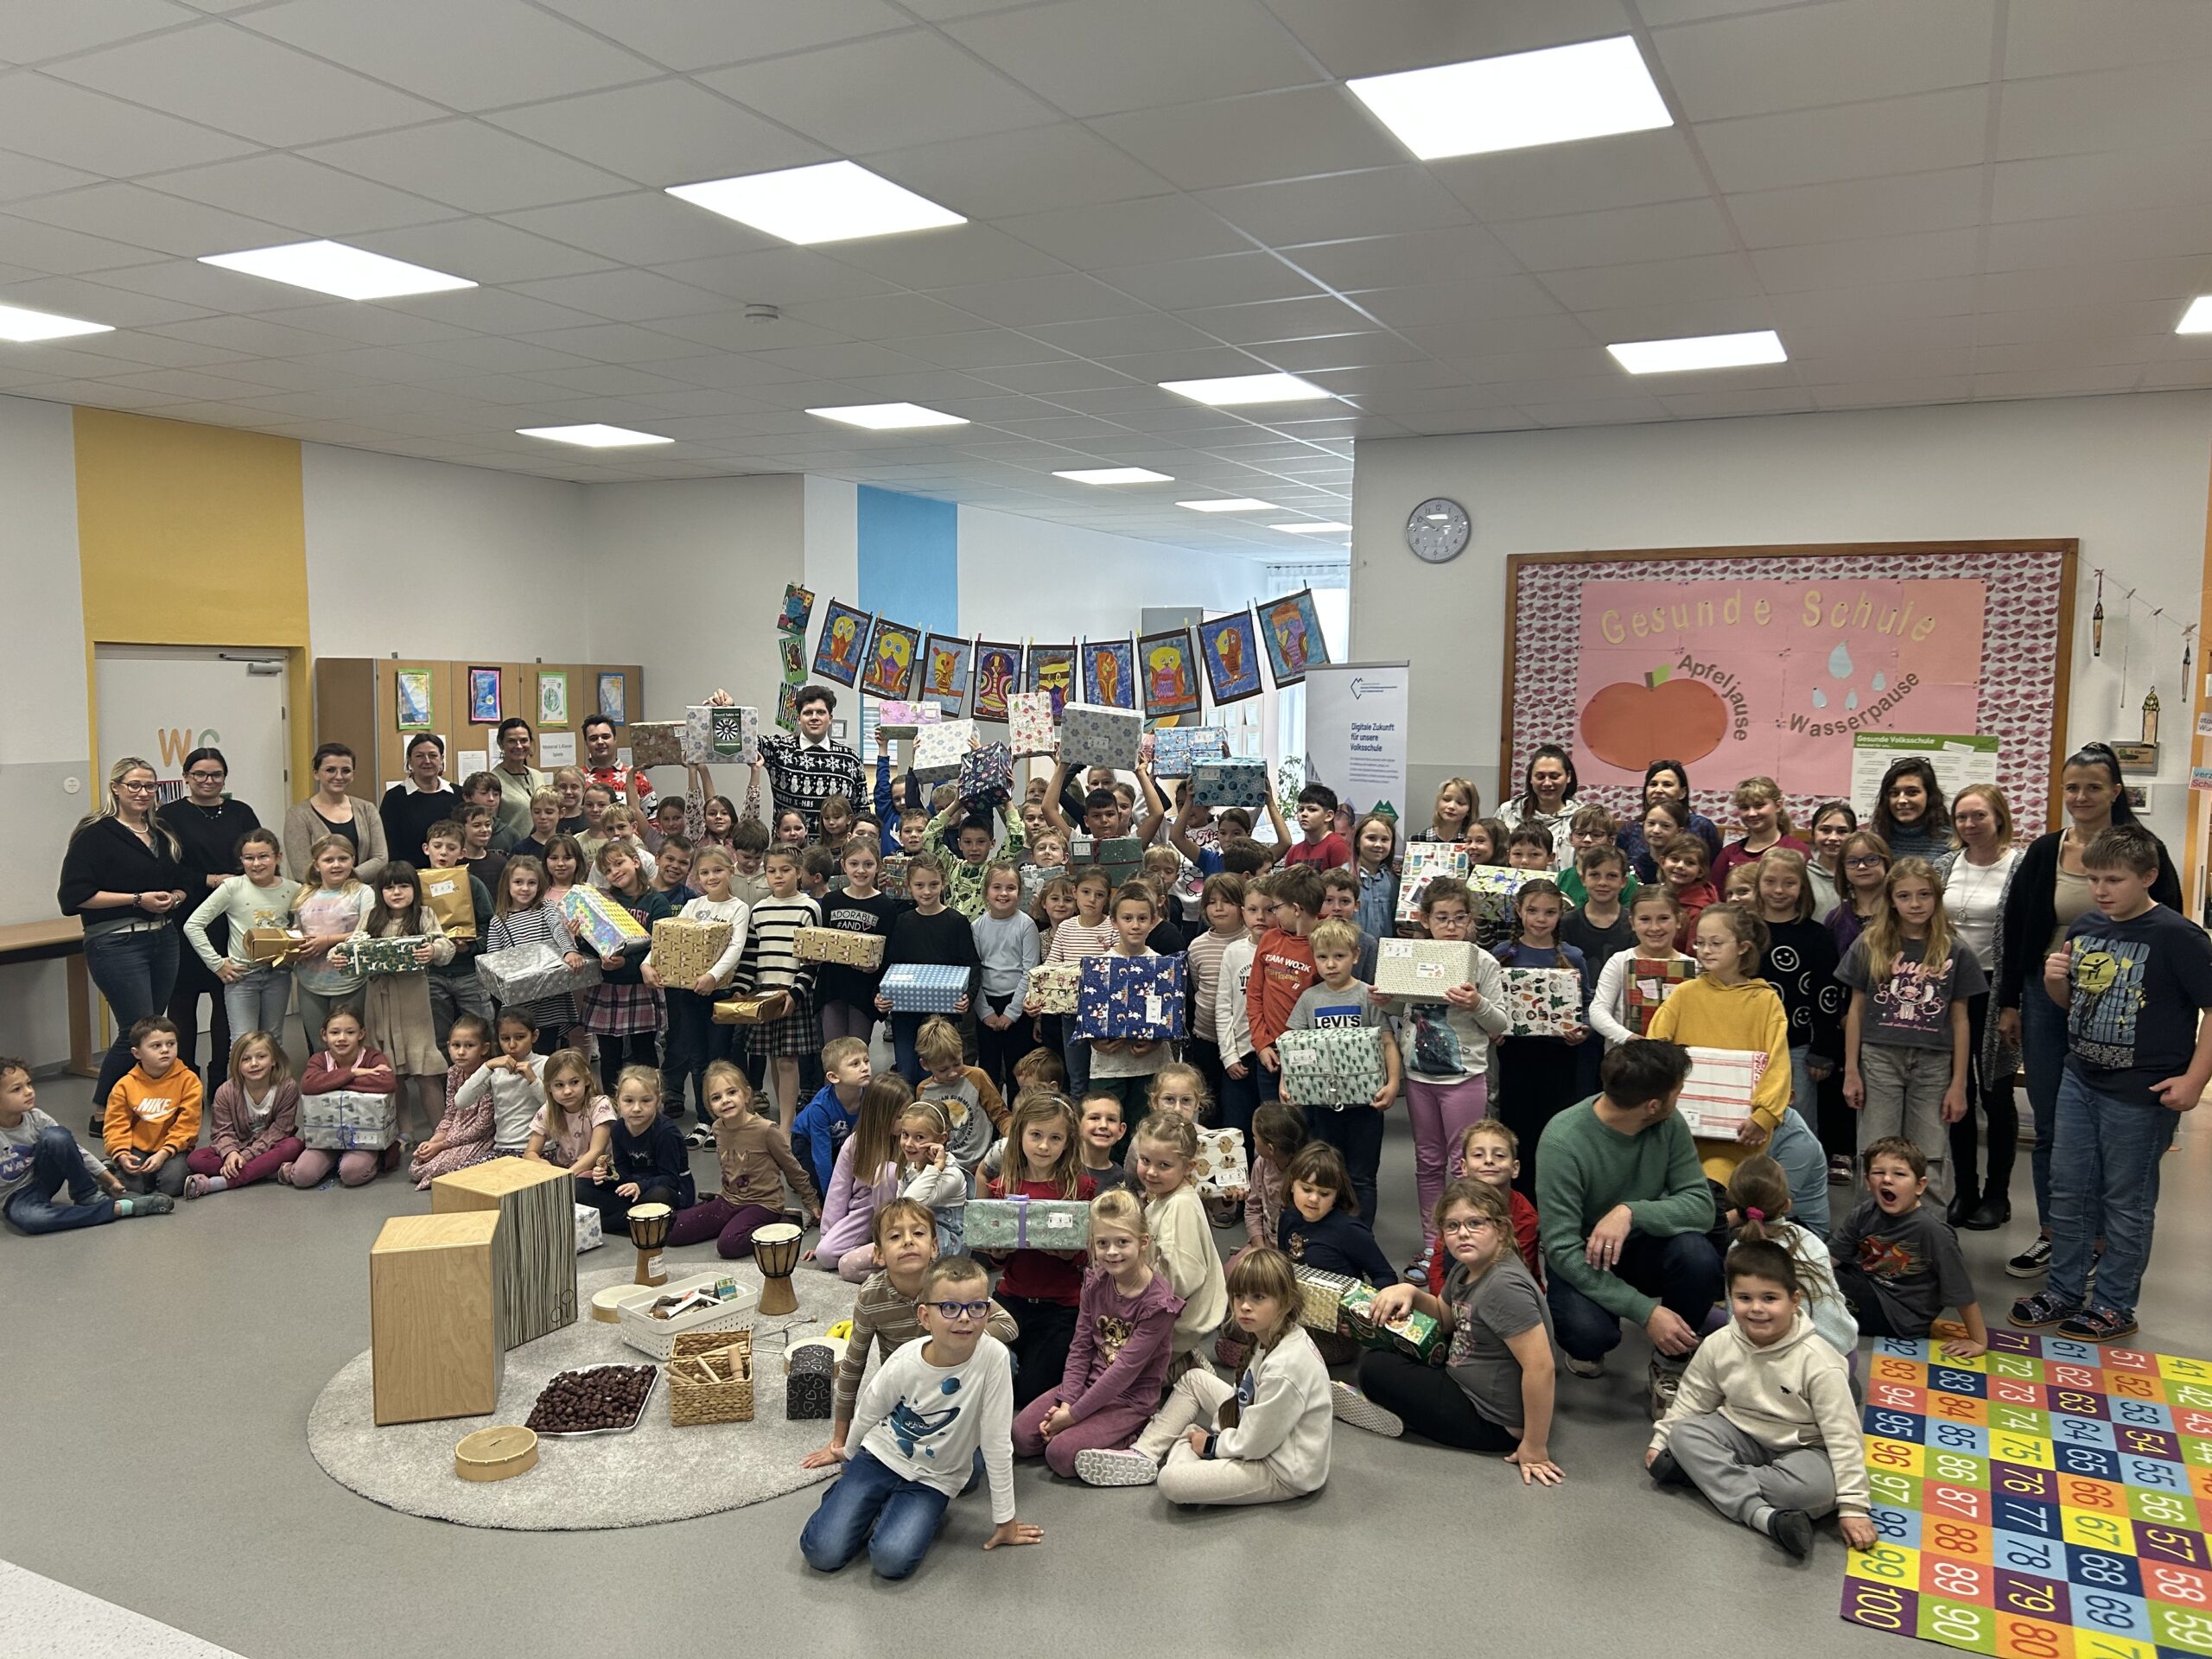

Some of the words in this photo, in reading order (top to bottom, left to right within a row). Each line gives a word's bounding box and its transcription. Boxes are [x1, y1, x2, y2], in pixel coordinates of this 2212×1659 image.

[1601, 588, 1771, 645] Gesunde
[1802, 590, 1936, 642] Schule
[1677, 653, 1749, 742] Apfeljause
[1789, 670, 1920, 738] Wasserpause
[1351, 723, 1371, 732] Digitale
[1373, 722, 1395, 732] Zukunft
[1351, 743, 1382, 752] Volksschule
[1857, 735, 1890, 744] Gesunde
[1891, 736, 1935, 745] Volksschule
[832, 910, 877, 925] ADORABLE
[837, 921, 861, 931] #AND
[1265, 954, 1284, 964] TEAM
[1285, 958, 1312, 973] WORK
[137, 1097, 173, 1113] NIKE
[3, 1155, 35, 1174] NAS
[1995, 1333, 2030, 1351] 71
[2051, 1341, 2087, 1359] 61
[1880, 1360, 1916, 1381] 93
[1998, 1357, 2032, 1378] 72
[2109, 1350, 2147, 1369] 51
[2169, 1359, 2208, 1378] 41
[1939, 1370, 1976, 1393] 83
[2056, 1365, 2093, 1389] 62
[2116, 1376, 2152, 1397] 52
[1878, 1385, 1916, 1408] 94
[1998, 1381, 2036, 1405] 73
[2059, 1391, 2098, 1414] 63
[2177, 1386, 2212, 1407] 42
[1938, 1395, 1976, 1420] 84
[2000, 1408, 2038, 1432] 74
[2120, 1402, 2160, 1425] 53
[1874, 1412, 1913, 1437] 95
[2062, 1420, 2101, 1443] 64
[1937, 1424, 1976, 1451] 85
[2002, 1438, 2043, 1462] 75
[2126, 1430, 2169, 1454] 54
[1872, 1442, 1911, 1468] 96
[2065, 1449, 2108, 1474] 65
[1936, 1454, 1978, 1483] 86
[2132, 1460, 2176, 1487] 55
[1870, 1473, 1910, 1503] 97
[2004, 1469, 2045, 1496] 76
[2069, 1481, 2113, 1508] 66
[1936, 1487, 1978, 1518] 87
[2139, 1493, 2186, 1522] 56
[1870, 1508, 1908, 1538] 98
[2005, 1502, 2048, 1532] 77
[1934, 1523, 1978, 1554] 88
[2074, 1516, 2123, 1547] 67
[2006, 1539, 2051, 1570] 78
[2146, 1529, 2196, 1562] 57
[1861, 1546, 1906, 1579] 99
[2079, 1554, 2129, 1587] 68
[1934, 1561, 1980, 1597] 89
[2154, 1568, 2207, 1603] 58
[1854, 1586, 1904, 1629] 100
[2008, 1580, 2056, 1612] 79
[1932, 1605, 1980, 1642] 90
[2085, 1595, 2134, 1629] 69
[2010, 1622, 2060, 1658] 80
[2164, 1611, 2212, 1649] 59
